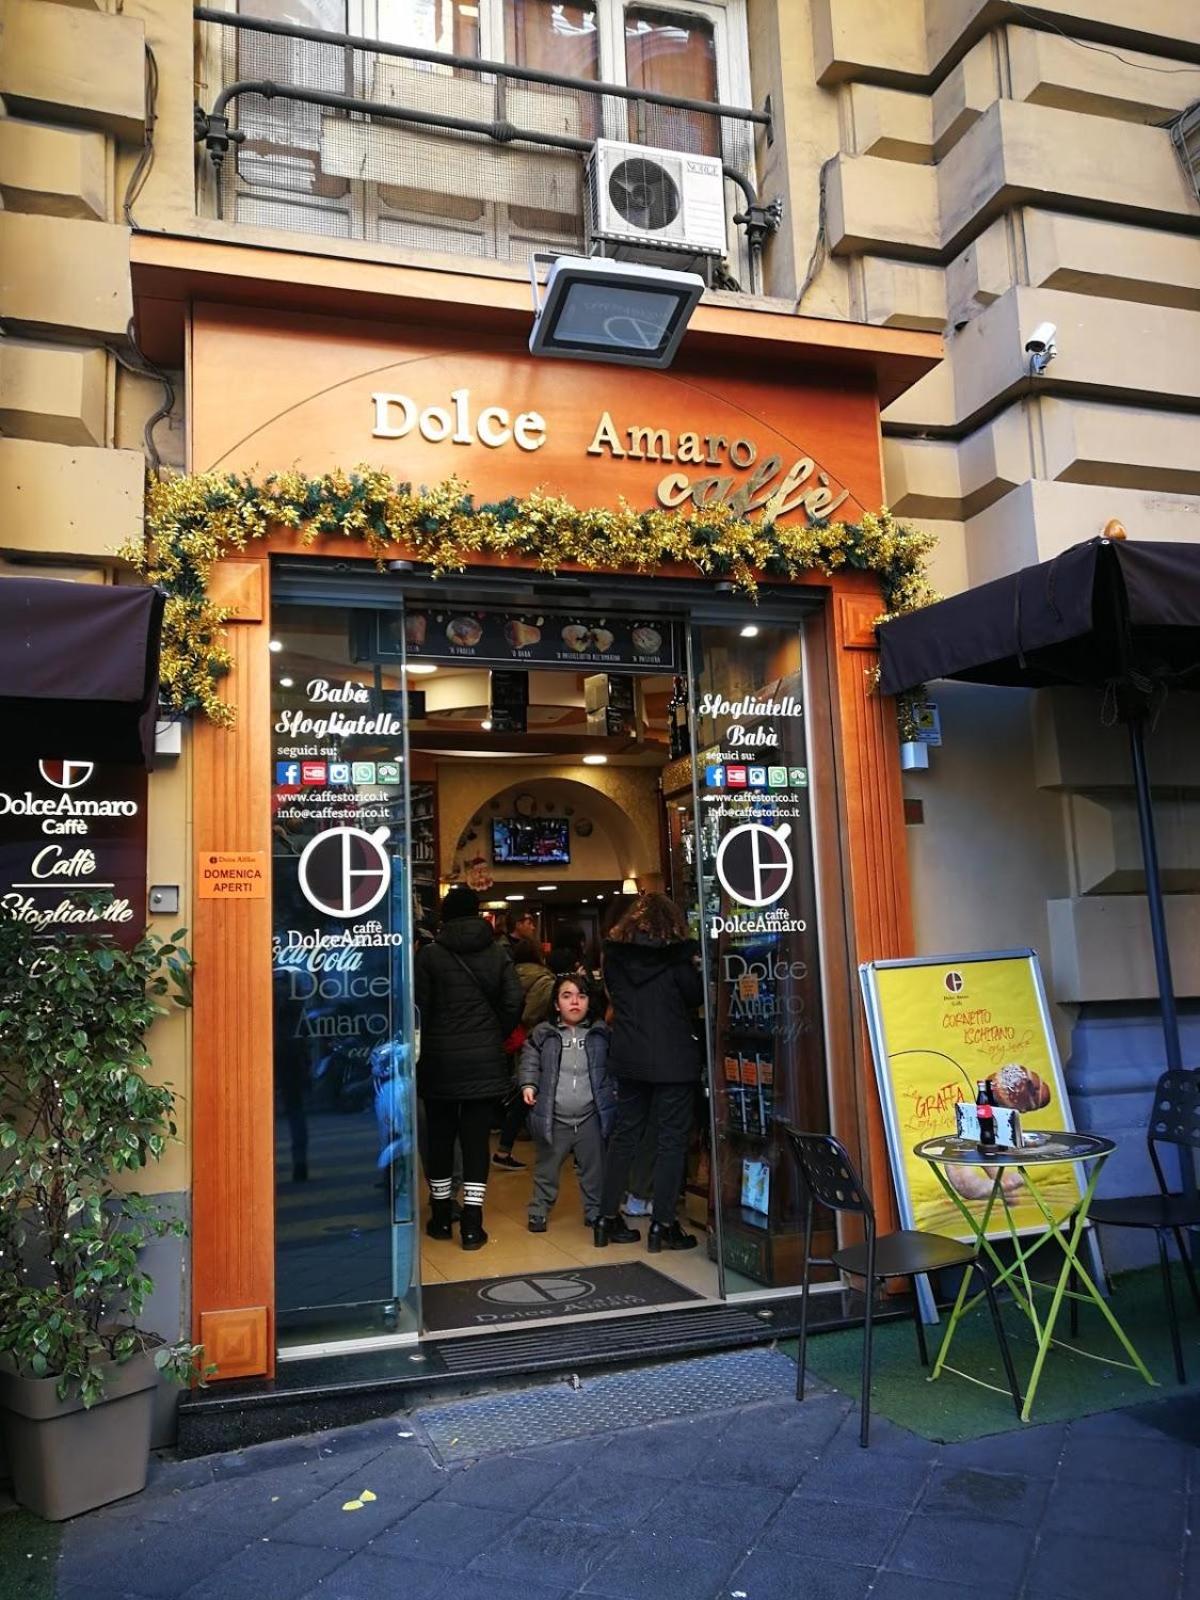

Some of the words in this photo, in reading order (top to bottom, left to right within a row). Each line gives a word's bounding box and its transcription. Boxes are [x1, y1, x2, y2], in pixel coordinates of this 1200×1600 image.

[371, 388, 547, 452] Dolce
[587, 411, 757, 468] Amaro
[657, 454, 850, 527] caffè
[306, 679, 370, 703] Babà
[699, 693, 803, 720] Sfogliatelle
[274, 710, 402, 739] Sfogliatelle
[726, 725, 780, 747] Babà
[277, 744, 318, 759] seguici
[320, 745, 338, 757] su:
[706, 750, 739, 763] seguici
[741, 752, 756, 761] su:
[0, 791, 138, 817] DolceAmaro
[276, 790, 390, 803] www.caffestorico.it
[277, 806, 390, 819] info@caffestorico.it
[708, 807, 801, 818] info@caffestorico.it
[41, 818, 89, 835] Caffè
[31, 844, 97, 879] Caffè
[204, 869, 262, 879] DOMENICA
[213, 882, 253, 892] APERTI
[0, 892, 134, 933] Sfoglialle
[765, 908, 790, 920] caffè
[352, 920, 383, 934] caffè
[711, 915, 807, 933] DolceAmaro
[287, 928, 403, 948] DolceAmaro
[306, 938, 364, 973] Cola
[722, 951, 809, 982] Dolce
[288, 968, 391, 1000] Dolce
[293, 1006, 389, 1038] Amaro
[942, 1008, 992, 1029] CORNETTO
[963, 1026, 1015, 1045] ISCHITANO
